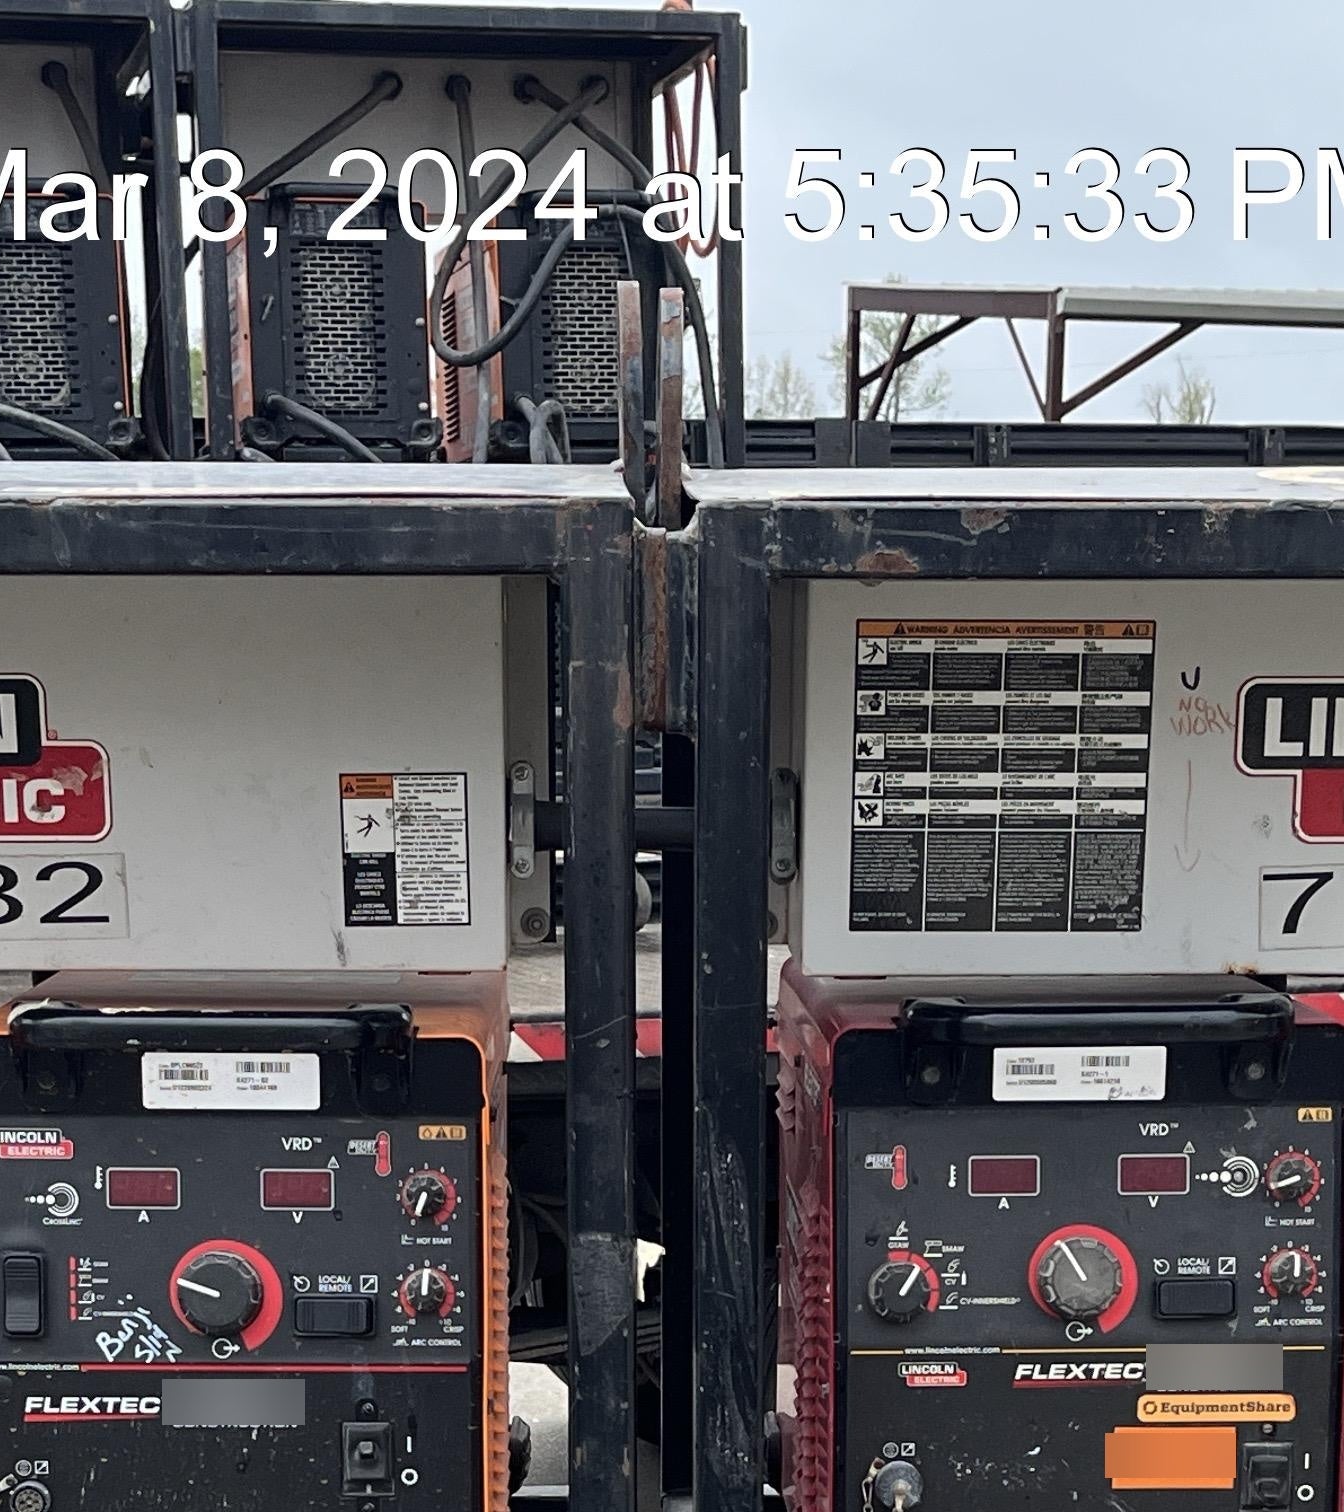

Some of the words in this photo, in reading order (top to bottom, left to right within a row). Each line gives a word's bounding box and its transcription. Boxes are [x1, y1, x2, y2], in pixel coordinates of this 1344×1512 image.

[907, 625, 948, 633] WARNING
[8, 1147, 65, 1156] ELECTRIC
[998, 1197, 1009, 1209] A
[1149, 1196, 1158, 1207] V
[138, 1210, 150, 1222] A
[292, 1212, 302, 1223] V
[1178, 1258, 1209, 1266] LOCAL/
[1178, 1266, 1210, 1274] REMOTE
[319, 1275, 351, 1283] LOCAL/
[319, 1284, 352, 1292] REMOTE
[902, 1365, 954, 1374] LINCOLN
[1014, 1362, 1144, 1380] FLEXTEC
[25, 1397, 160, 1413] FLEXTEC
[1160, 1401, 1290, 1414] EquipmentShare
